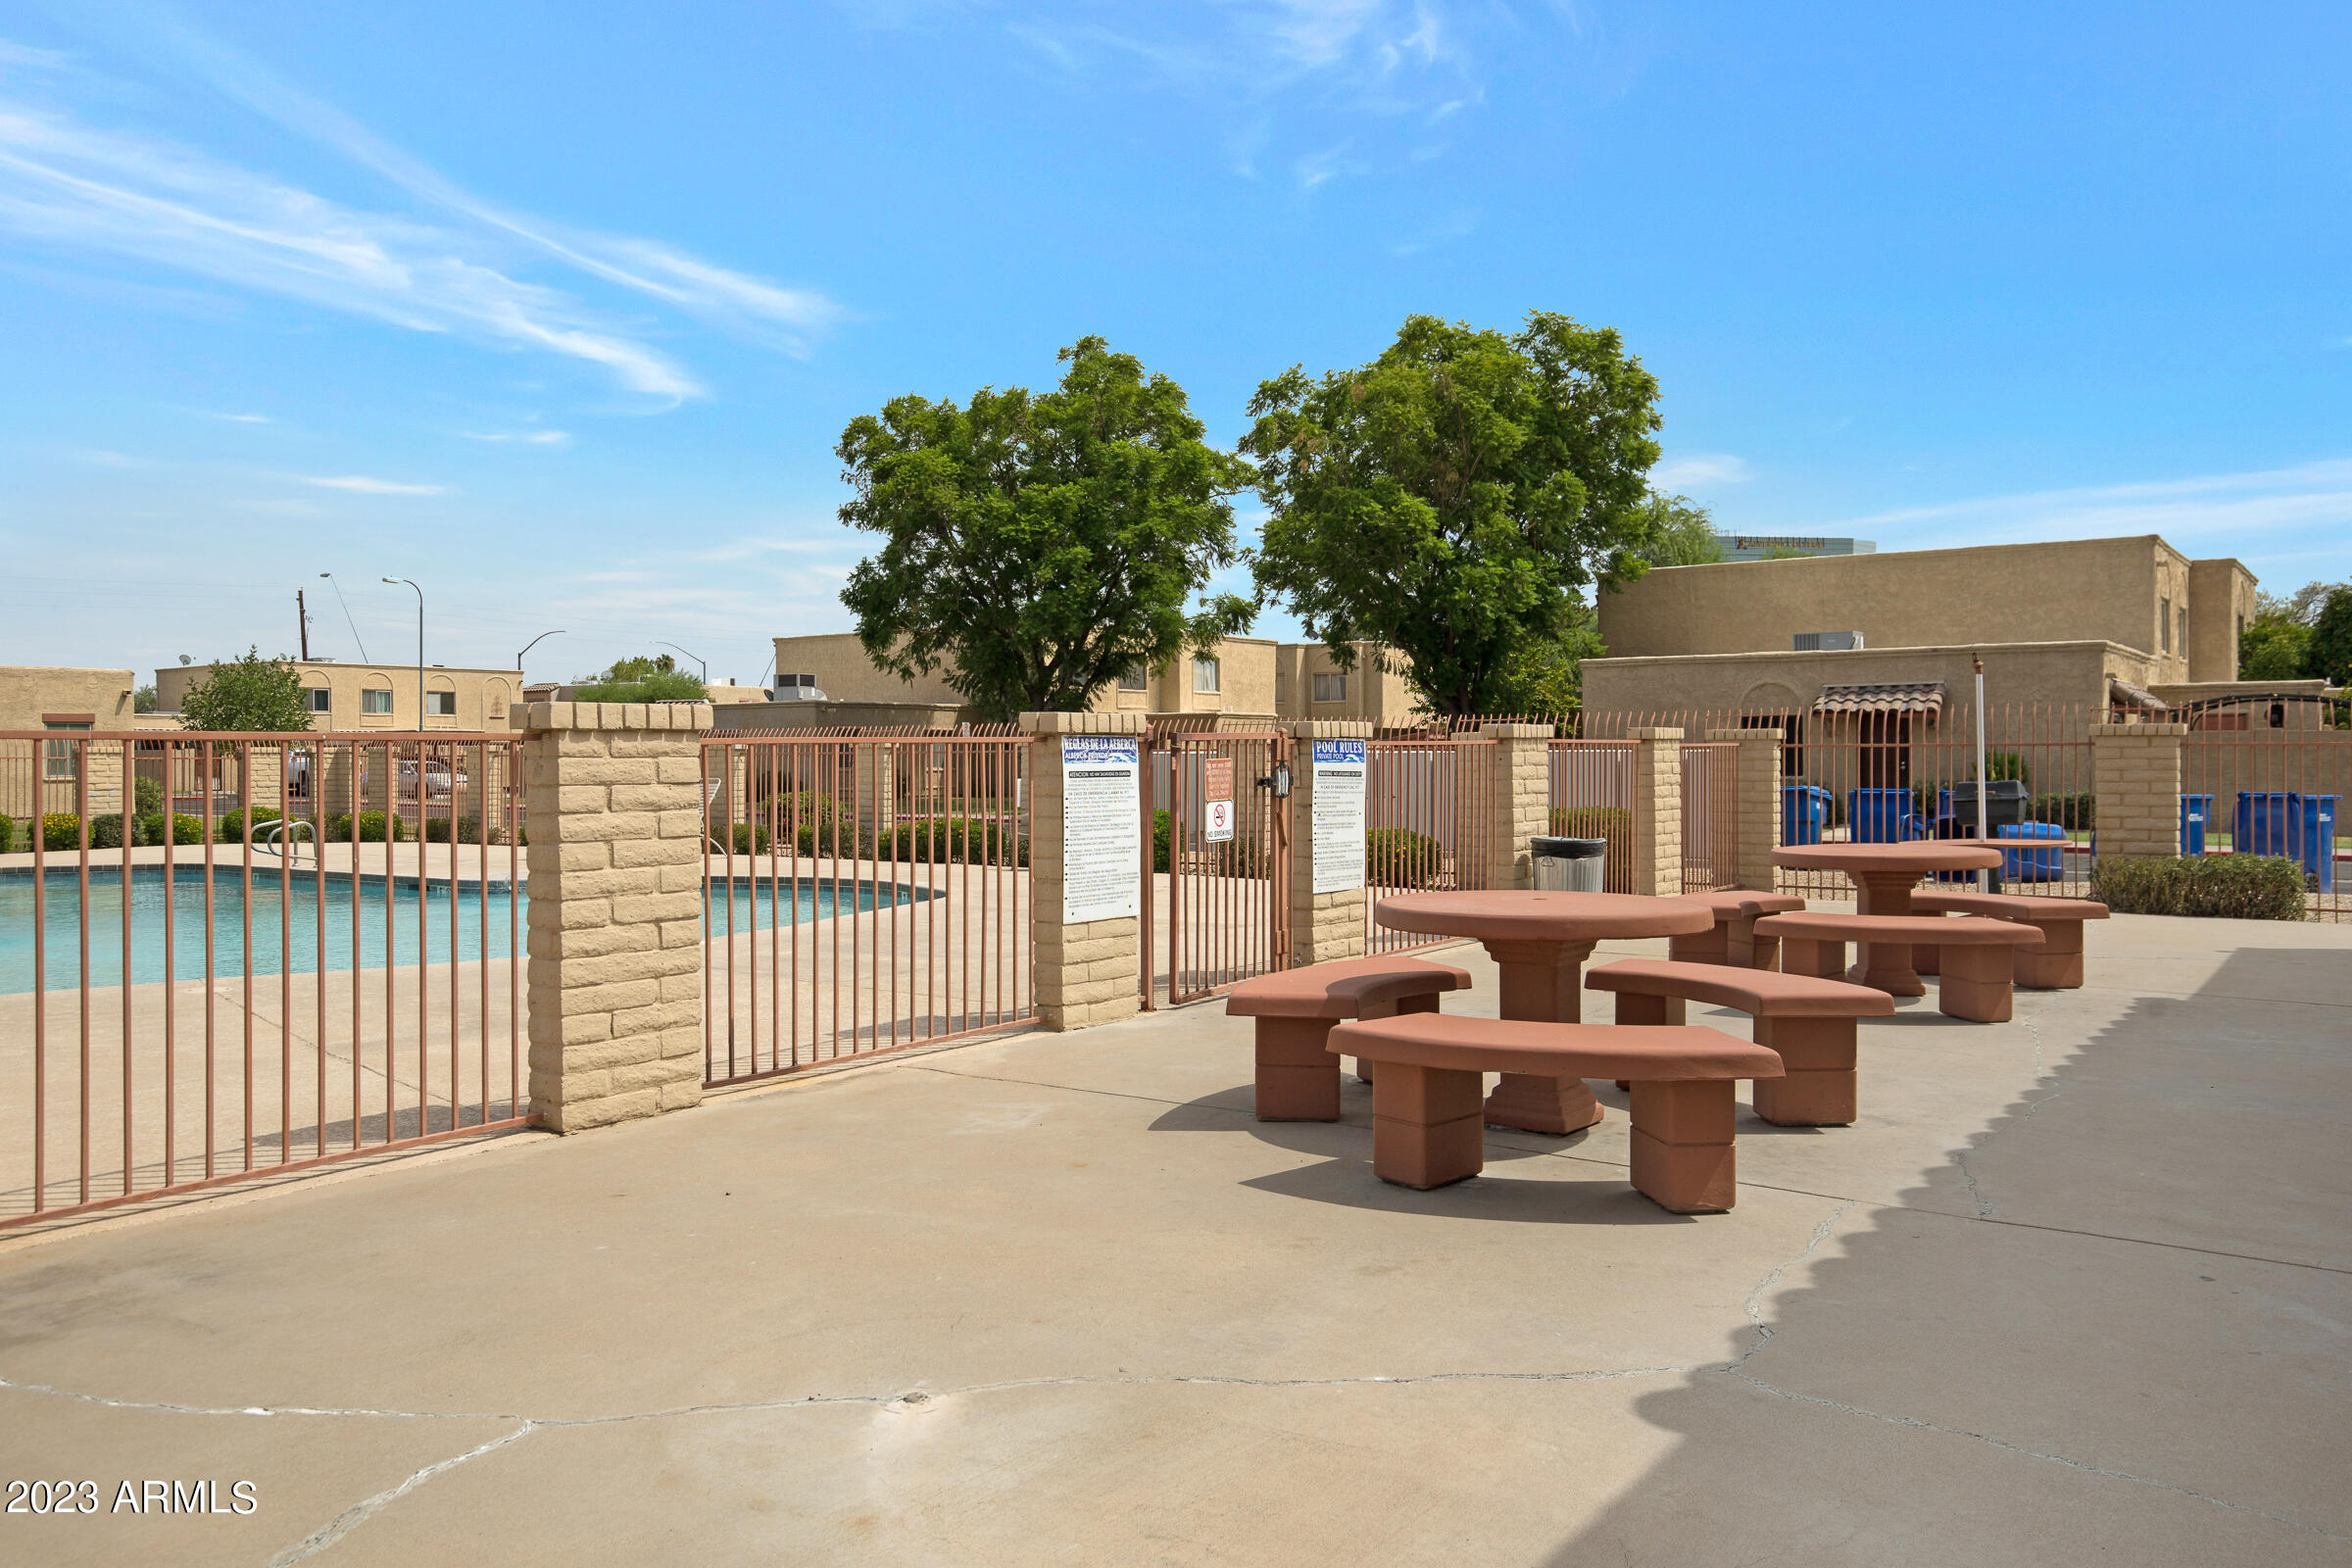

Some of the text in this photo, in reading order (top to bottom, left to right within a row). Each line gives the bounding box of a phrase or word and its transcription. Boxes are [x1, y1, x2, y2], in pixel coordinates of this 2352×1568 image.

[1064, 738, 1089, 750] REGLAS
[1090, 738, 1100, 750] DE
[1101, 738, 1108, 750] LA
[1316, 741, 1362, 754] POOL RULES
[1213, 829, 1232, 838] SMOKING
